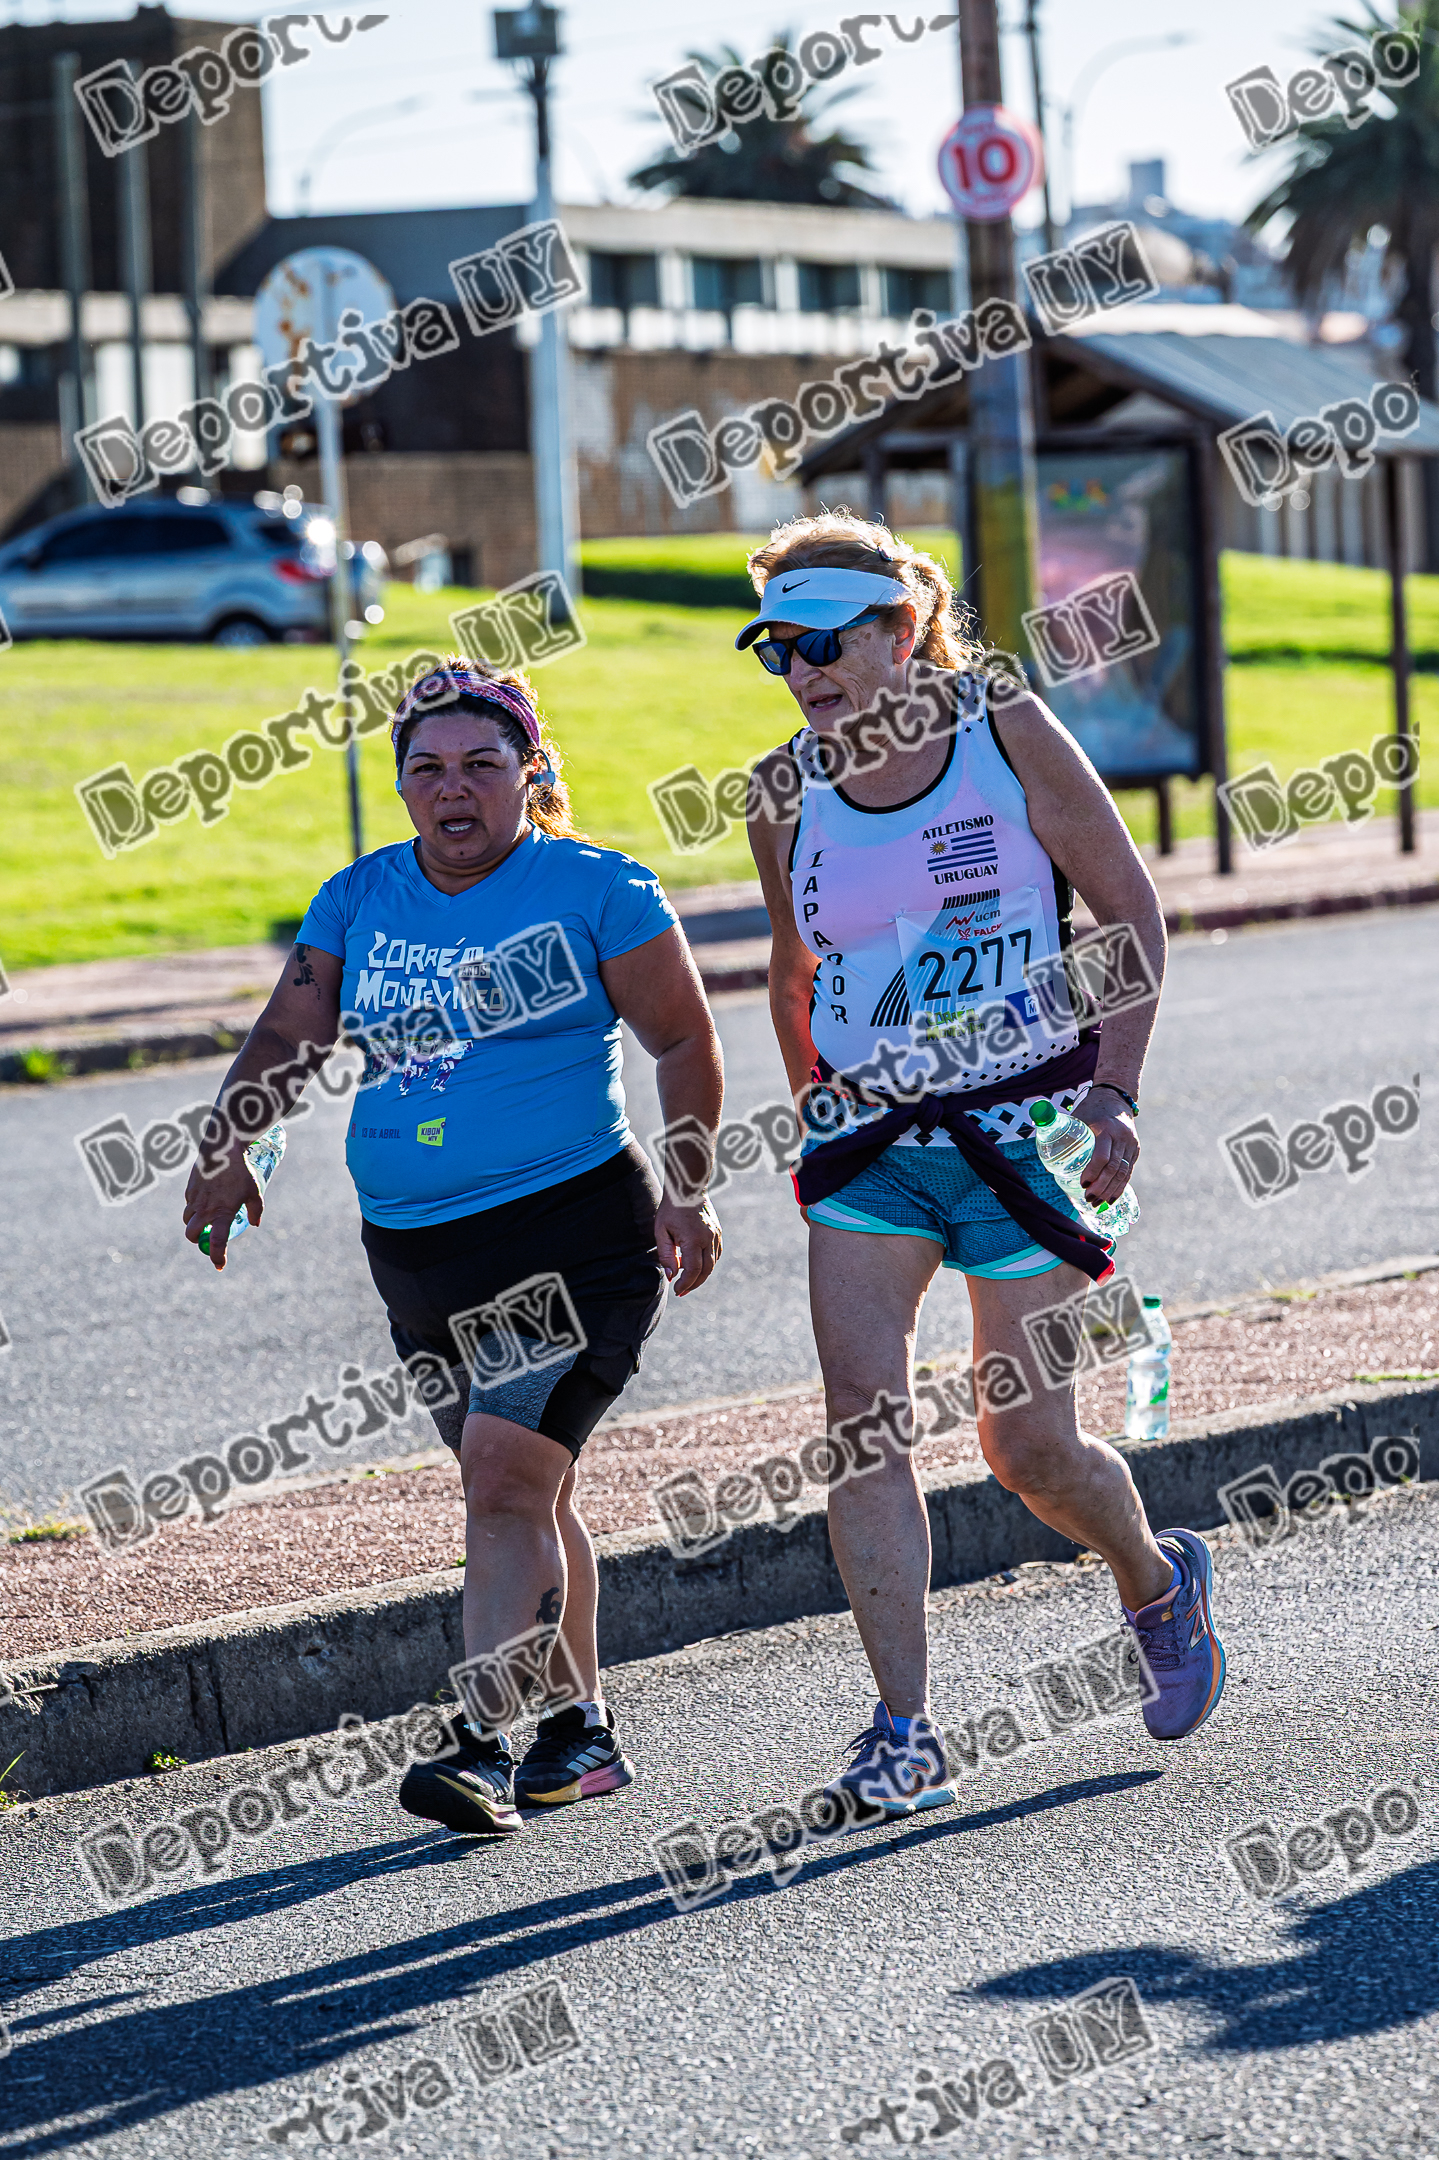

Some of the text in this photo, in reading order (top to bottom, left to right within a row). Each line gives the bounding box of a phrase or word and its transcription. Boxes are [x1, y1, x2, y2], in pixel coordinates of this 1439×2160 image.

[952, 138, 1018, 190] 10
[921, 814, 994, 840] ATLETISMO
[933, 863, 998, 885] URUGUAY
[975, 909, 1001, 923] ucm
[918, 928, 1032, 1001] 2277
[354, 969, 504, 1013] MONTEVIDEO
[369, 1127, 377, 1139] DE
[378, 1128, 401, 1139] ABRIL
[421, 1127, 440, 1135] KIBON
